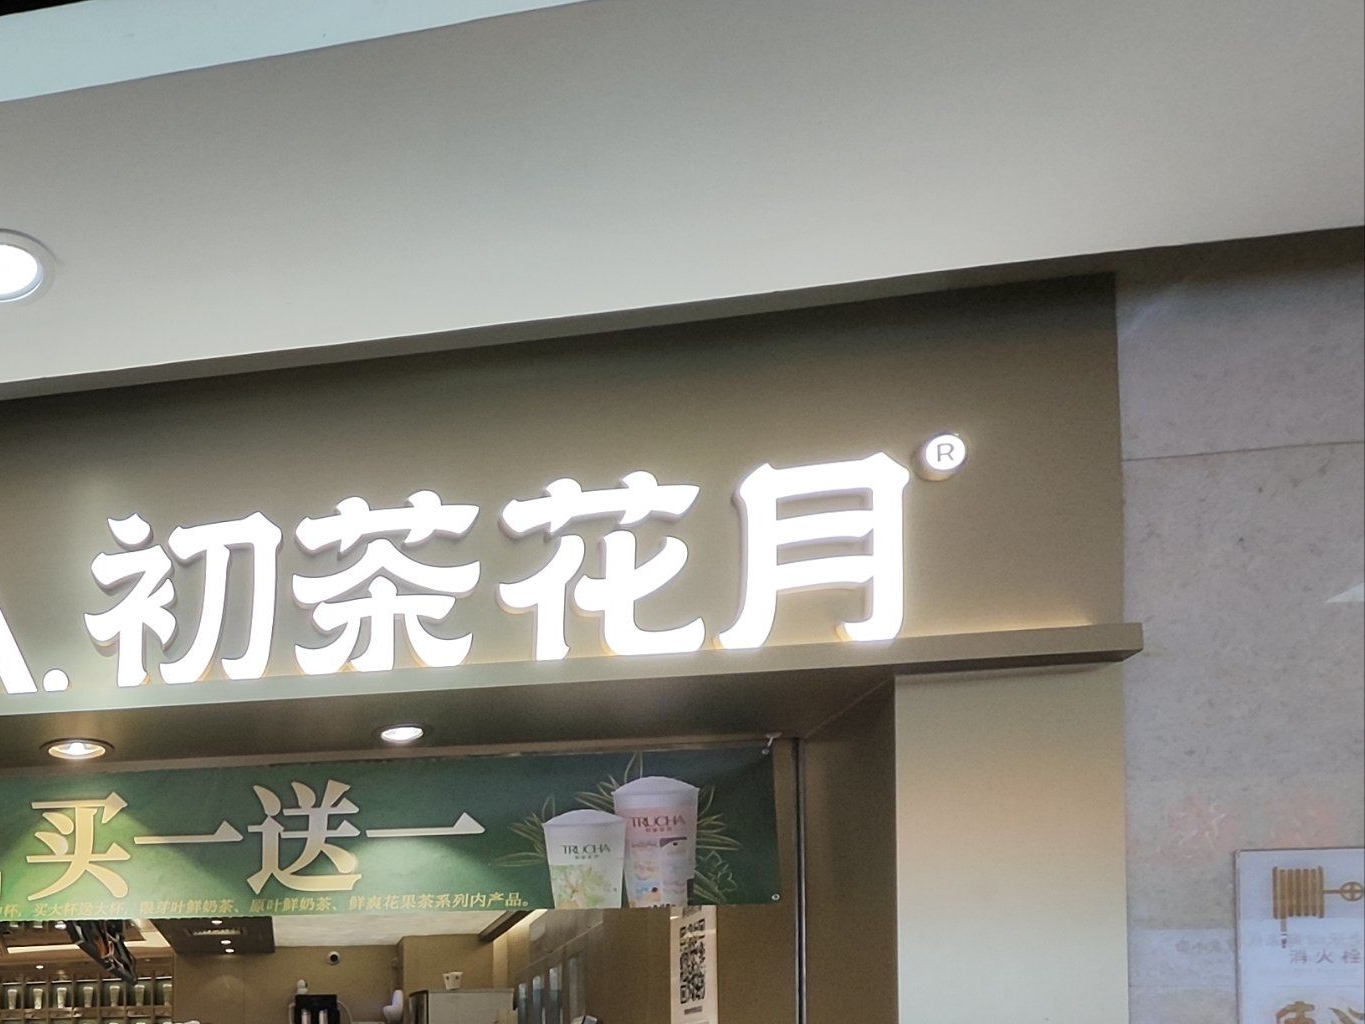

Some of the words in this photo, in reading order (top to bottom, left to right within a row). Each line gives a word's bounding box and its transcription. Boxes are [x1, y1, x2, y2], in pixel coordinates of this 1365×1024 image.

[84, 451, 910, 690] 初茶花月
[26, 779, 486, 902] 买一送一
[562, 843, 610, 856] TRUCHA
